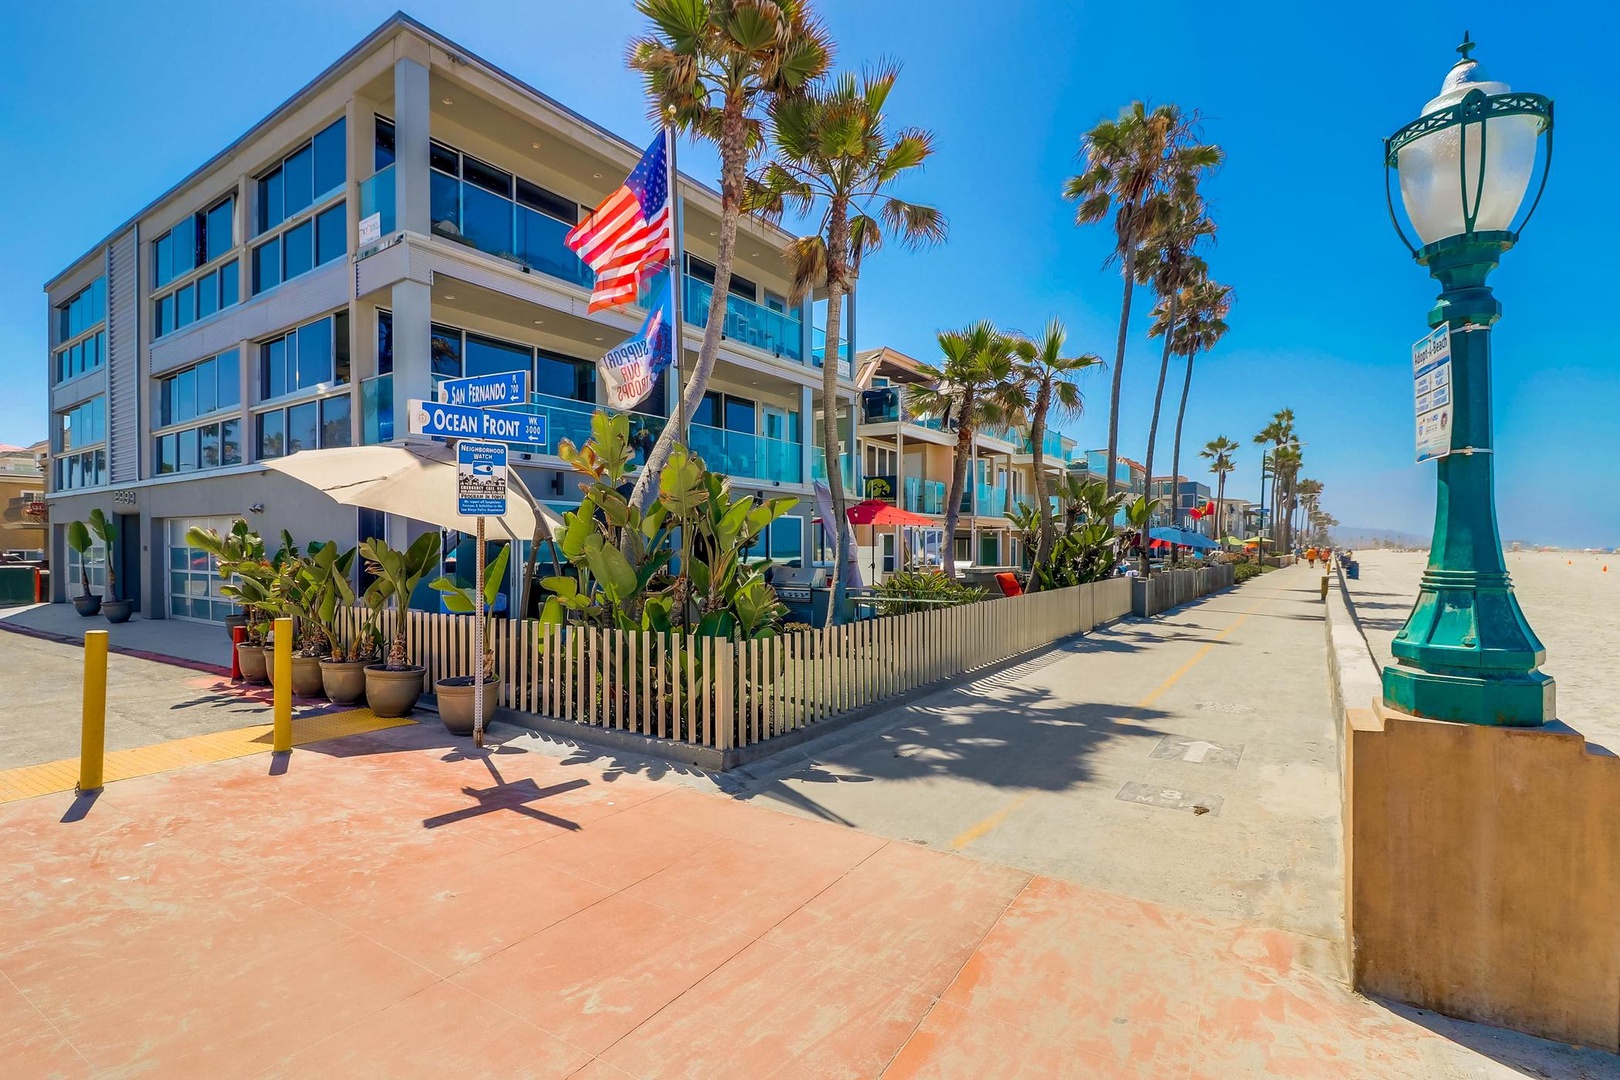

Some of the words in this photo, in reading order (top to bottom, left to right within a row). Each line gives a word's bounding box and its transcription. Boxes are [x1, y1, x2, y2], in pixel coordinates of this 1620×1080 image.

[451, 386, 466, 405] SAN
[468, 382, 507, 403] FERNANDO
[510, 384, 519, 394] 700
[433, 409, 478, 434] OCEAN
[483, 414, 520, 437] FRONT
[528, 417, 538, 425] WK
[525, 426, 541, 434] 3000
[460, 444, 505, 455] NEIGHBORHOOD
